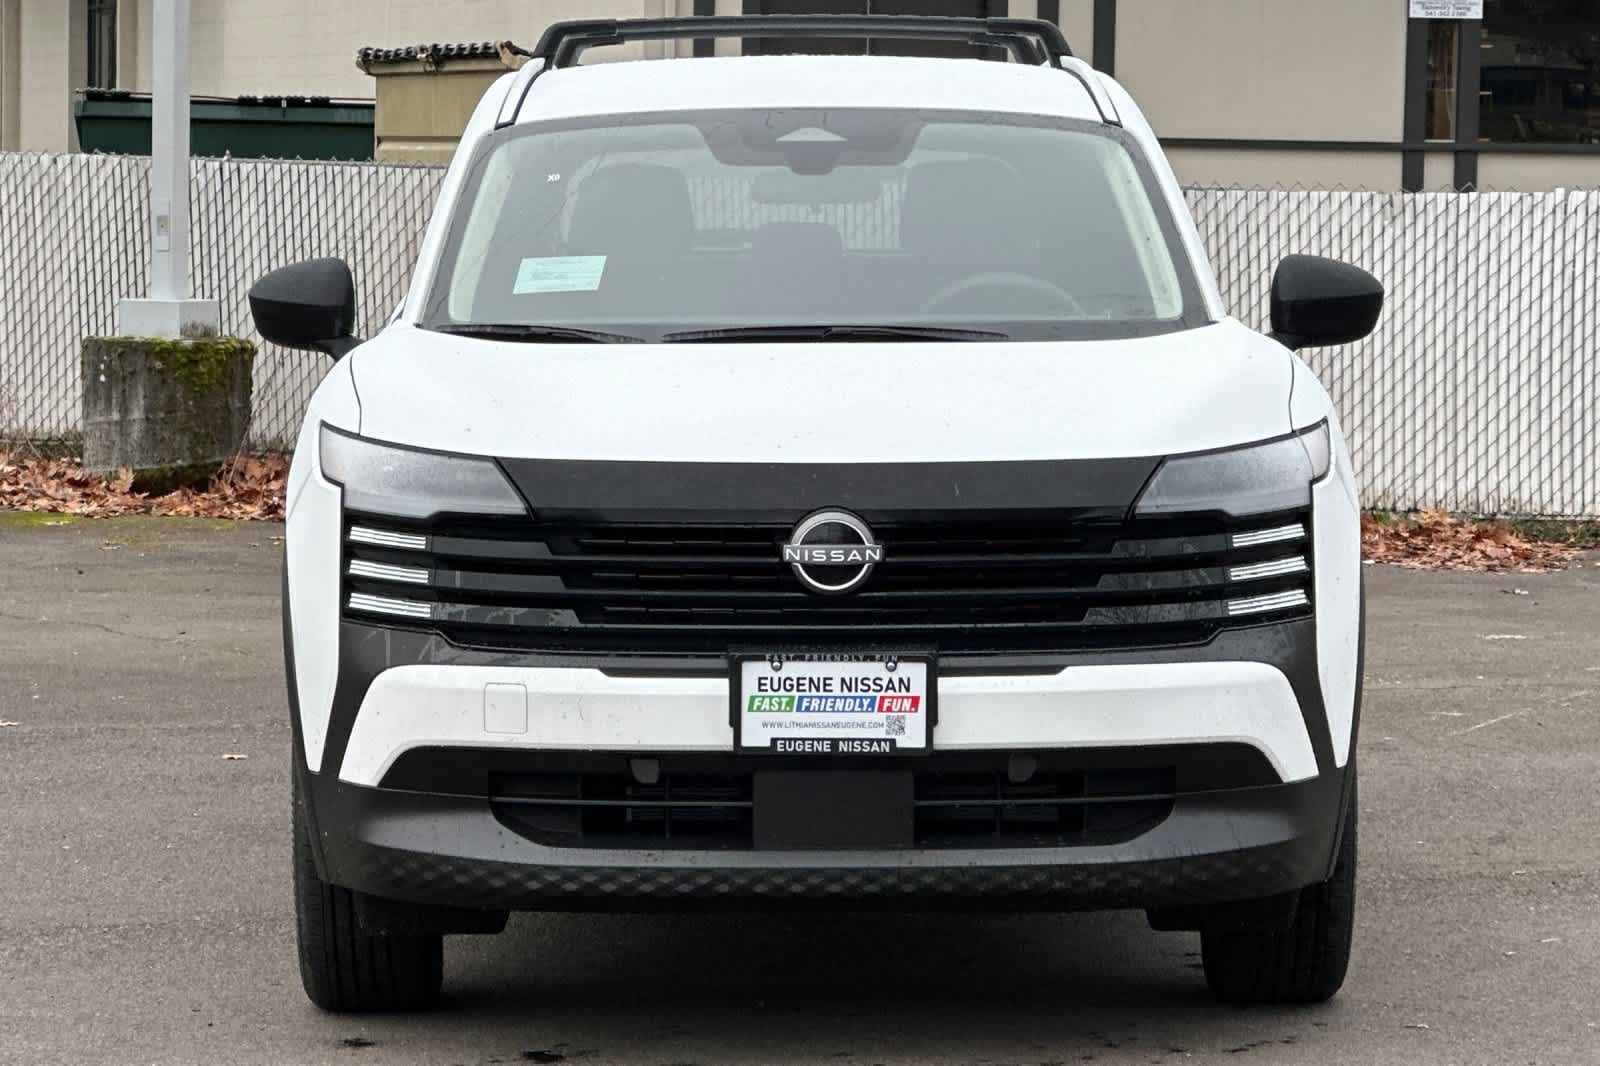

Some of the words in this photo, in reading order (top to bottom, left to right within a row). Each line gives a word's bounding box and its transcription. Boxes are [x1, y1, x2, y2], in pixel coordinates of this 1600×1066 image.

[785, 548, 880, 562] NISSAN
[757, 676, 834, 693] EUGENE
[840, 676, 911, 693] NISSAN
[752, 697, 790, 711] FAST.
[801, 697, 873, 712] FRIENDLY.
[882, 697, 916, 712] FUN.
[761, 721, 885, 729] WWW.LITHIANISSANEUGENE.COM
[776, 740, 832, 752] EUGENE
[839, 740, 891, 753] NISSAN
